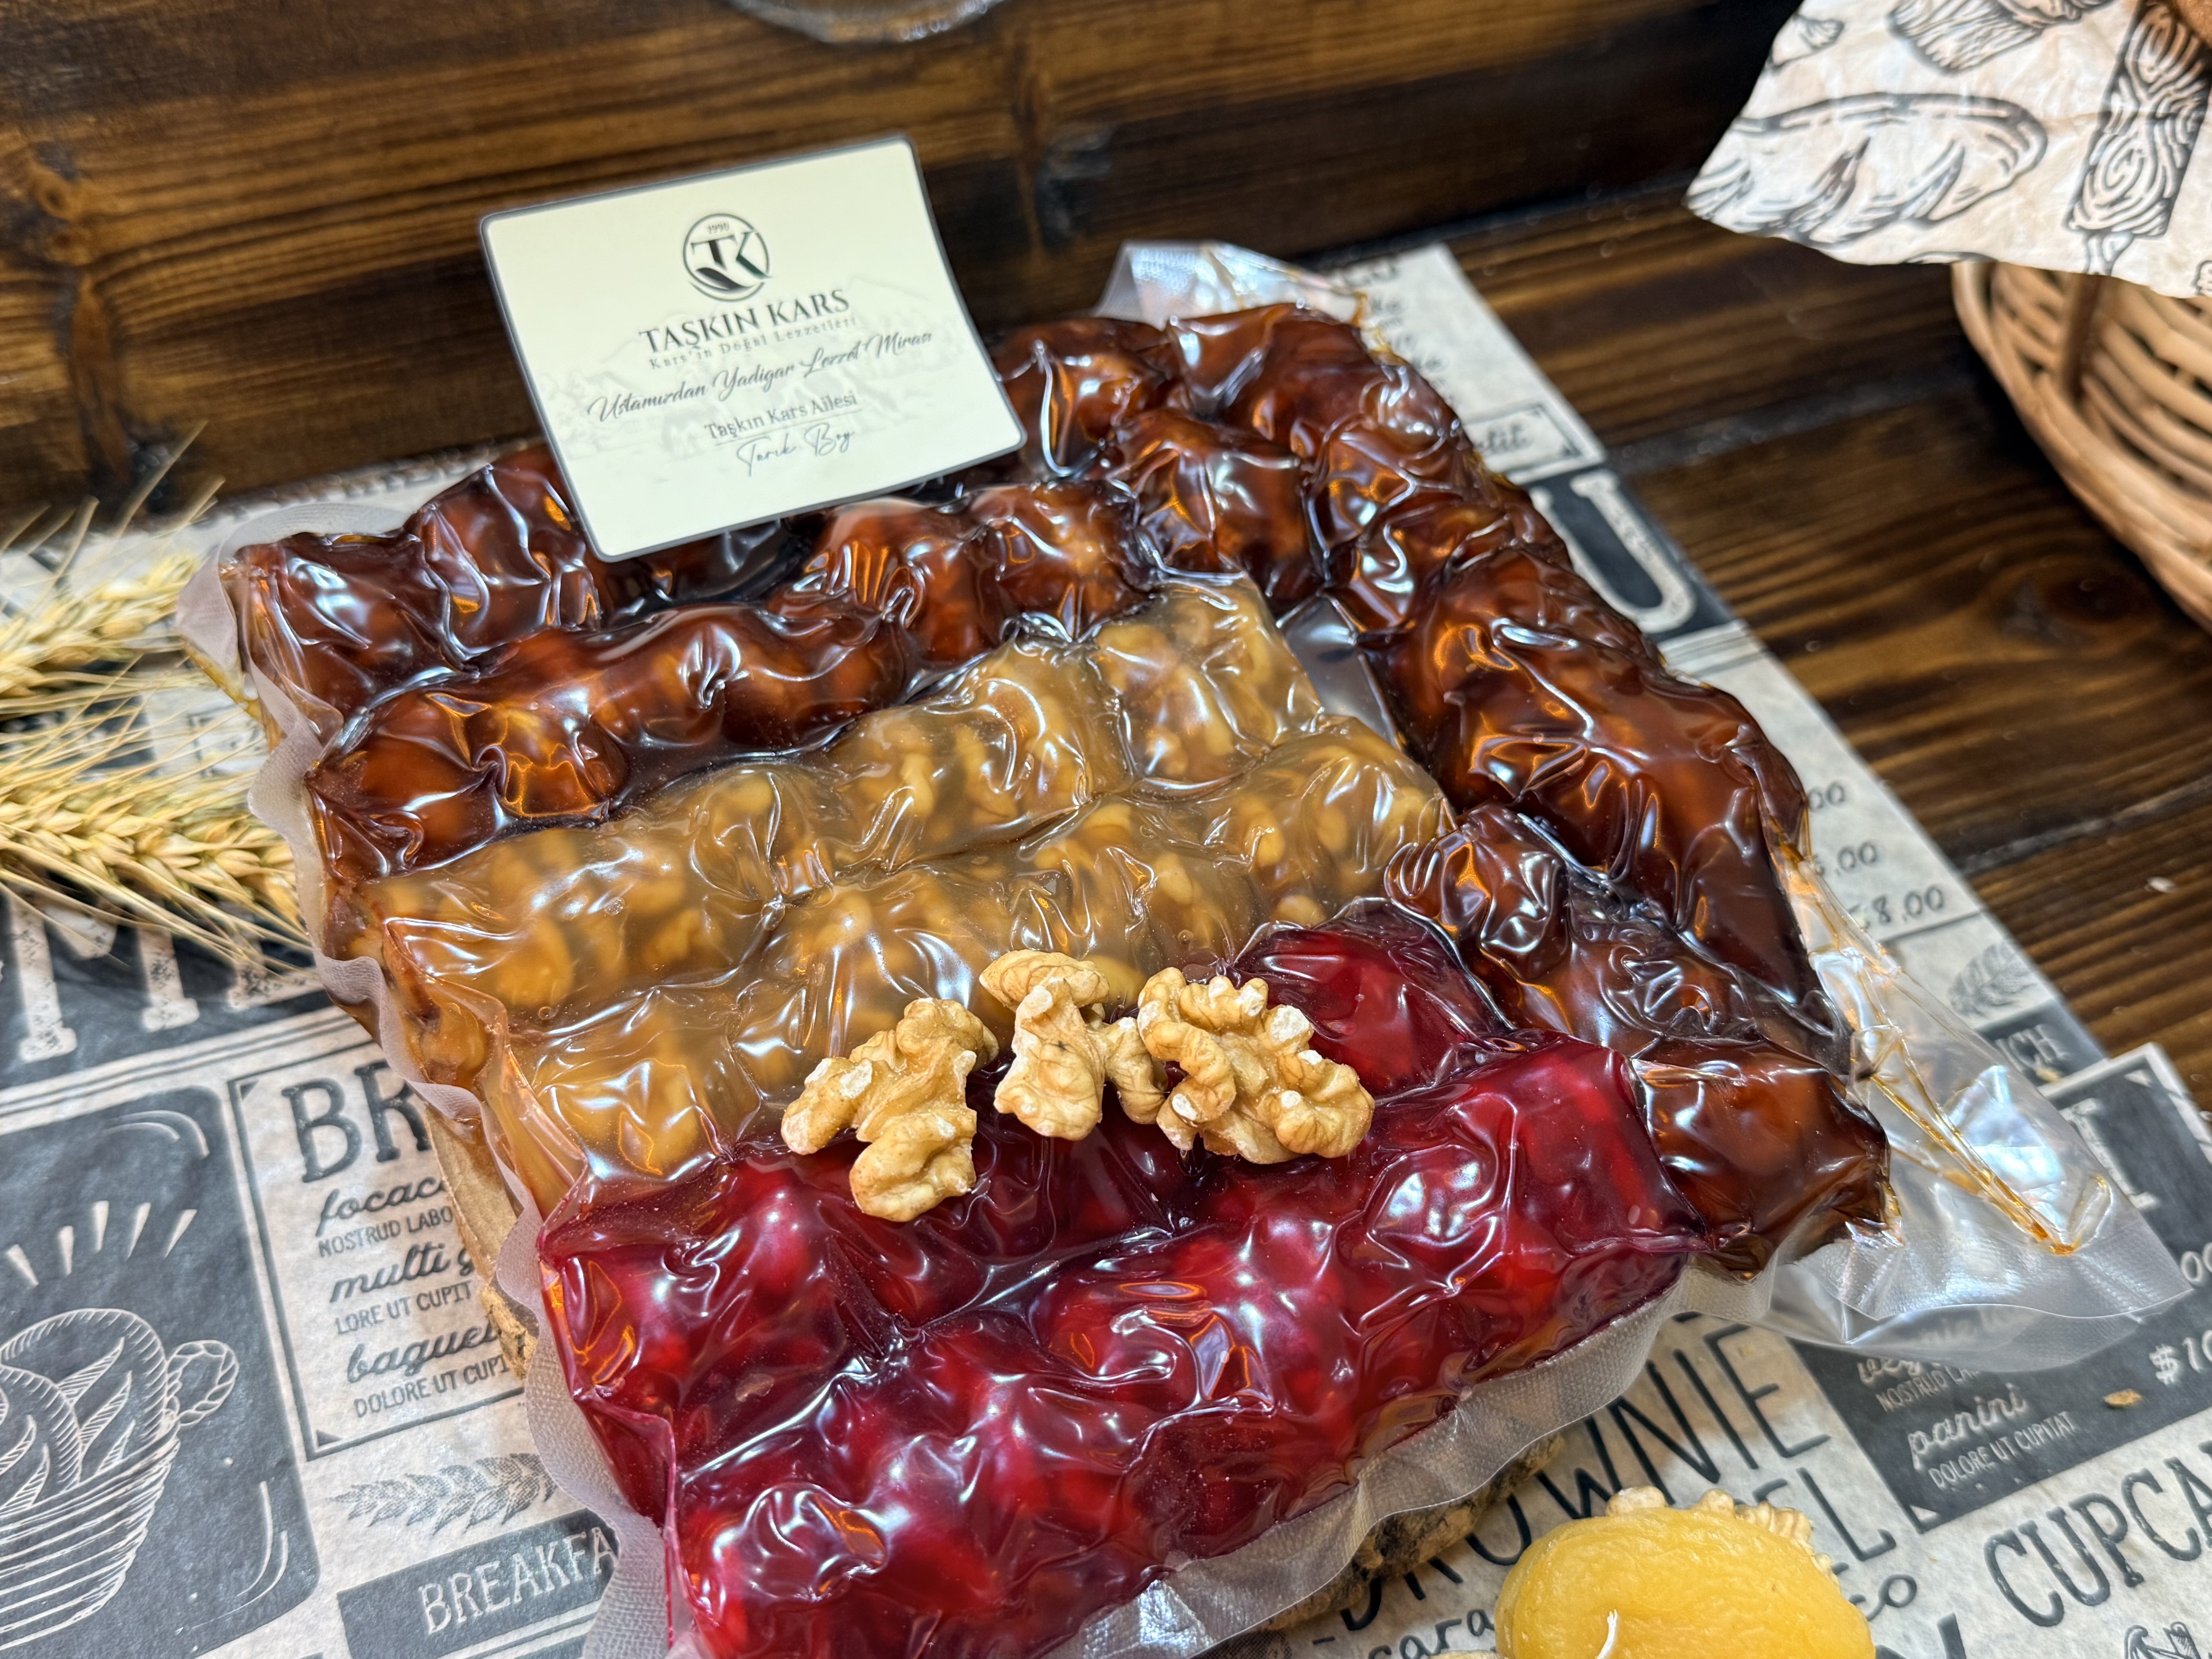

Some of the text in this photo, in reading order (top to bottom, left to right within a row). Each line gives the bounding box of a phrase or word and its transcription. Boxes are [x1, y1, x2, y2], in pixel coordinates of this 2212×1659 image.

[638, 288, 850, 354] TAŞKIN KARS
[712, 361, 795, 402] Yadigar
[704, 385, 858, 438] Taşkın Kars Ailesi
[318, 1221, 402, 1258] NOSTRUD
[329, 1242, 451, 1304] multi
[335, 1304, 383, 1334] LORE
[386, 1296, 411, 1319] UT
[353, 1377, 431, 1418] DOLORE
[432, 1369, 459, 1394] UT
[1907, 1382, 2028, 1472] panini
[1928, 1410, 2080, 1492] DOLORE UT CUPITAT
